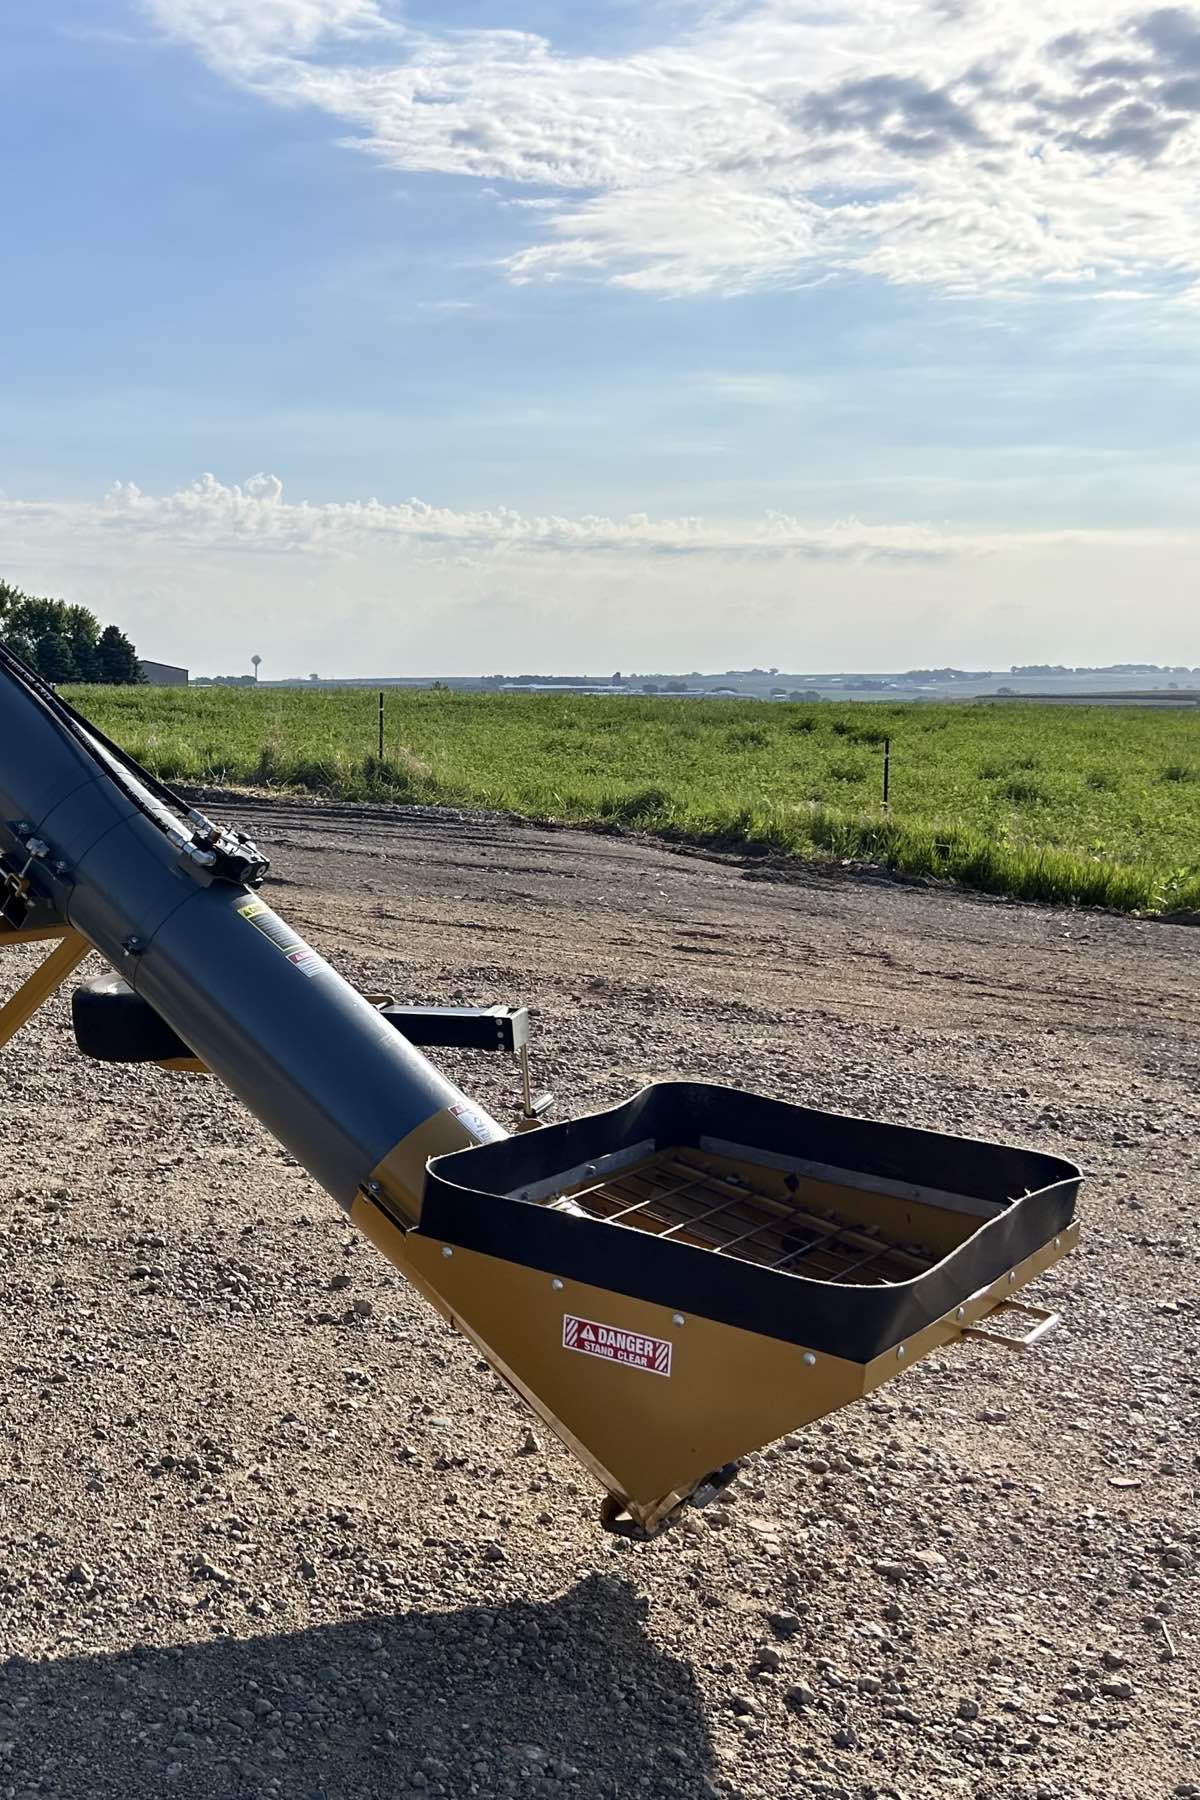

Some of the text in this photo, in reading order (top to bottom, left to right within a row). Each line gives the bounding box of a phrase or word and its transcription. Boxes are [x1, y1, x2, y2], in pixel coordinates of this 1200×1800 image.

[583, 1340, 648, 1367] STAND CLEAR
[597, 1326, 654, 1357] DANGER
